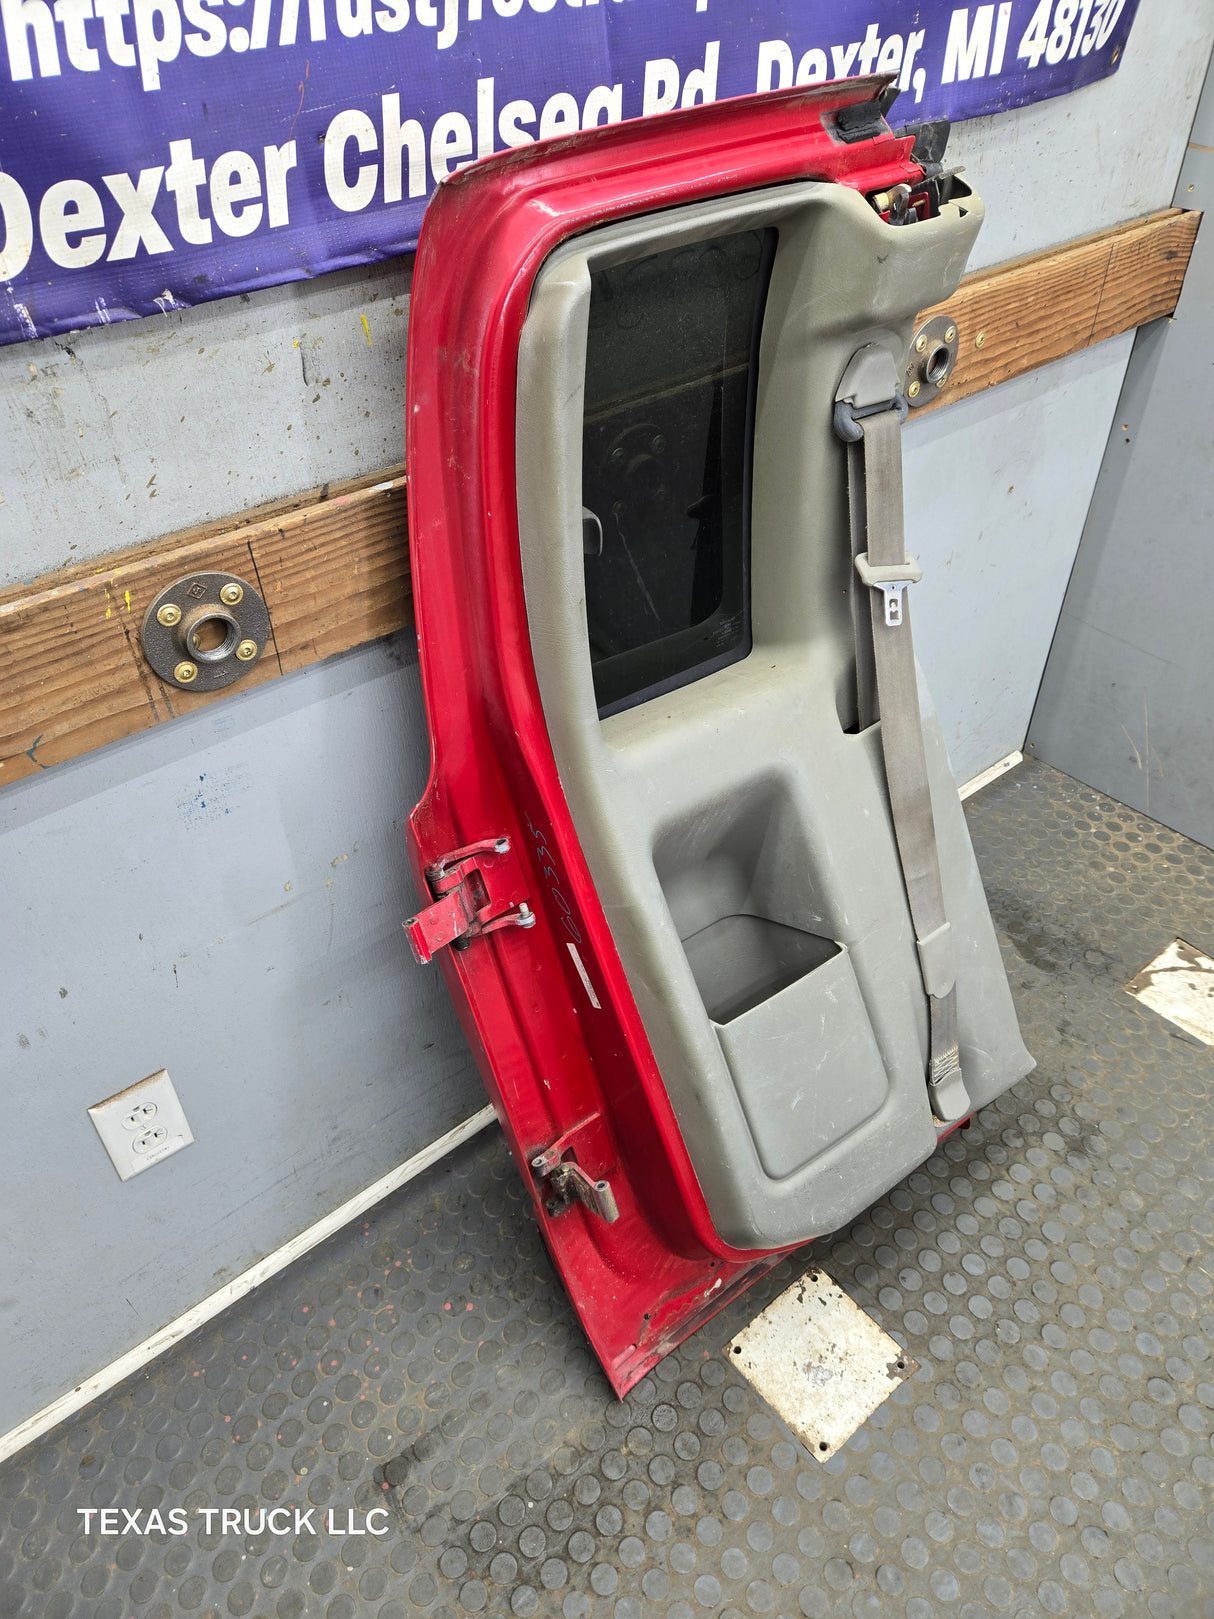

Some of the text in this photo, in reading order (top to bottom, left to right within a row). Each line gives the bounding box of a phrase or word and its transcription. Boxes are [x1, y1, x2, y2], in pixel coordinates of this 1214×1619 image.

[323, 77, 624, 212] Chelsea
[941, 1, 1012, 85] MI
[1016, 0, 1126, 69] 48130
